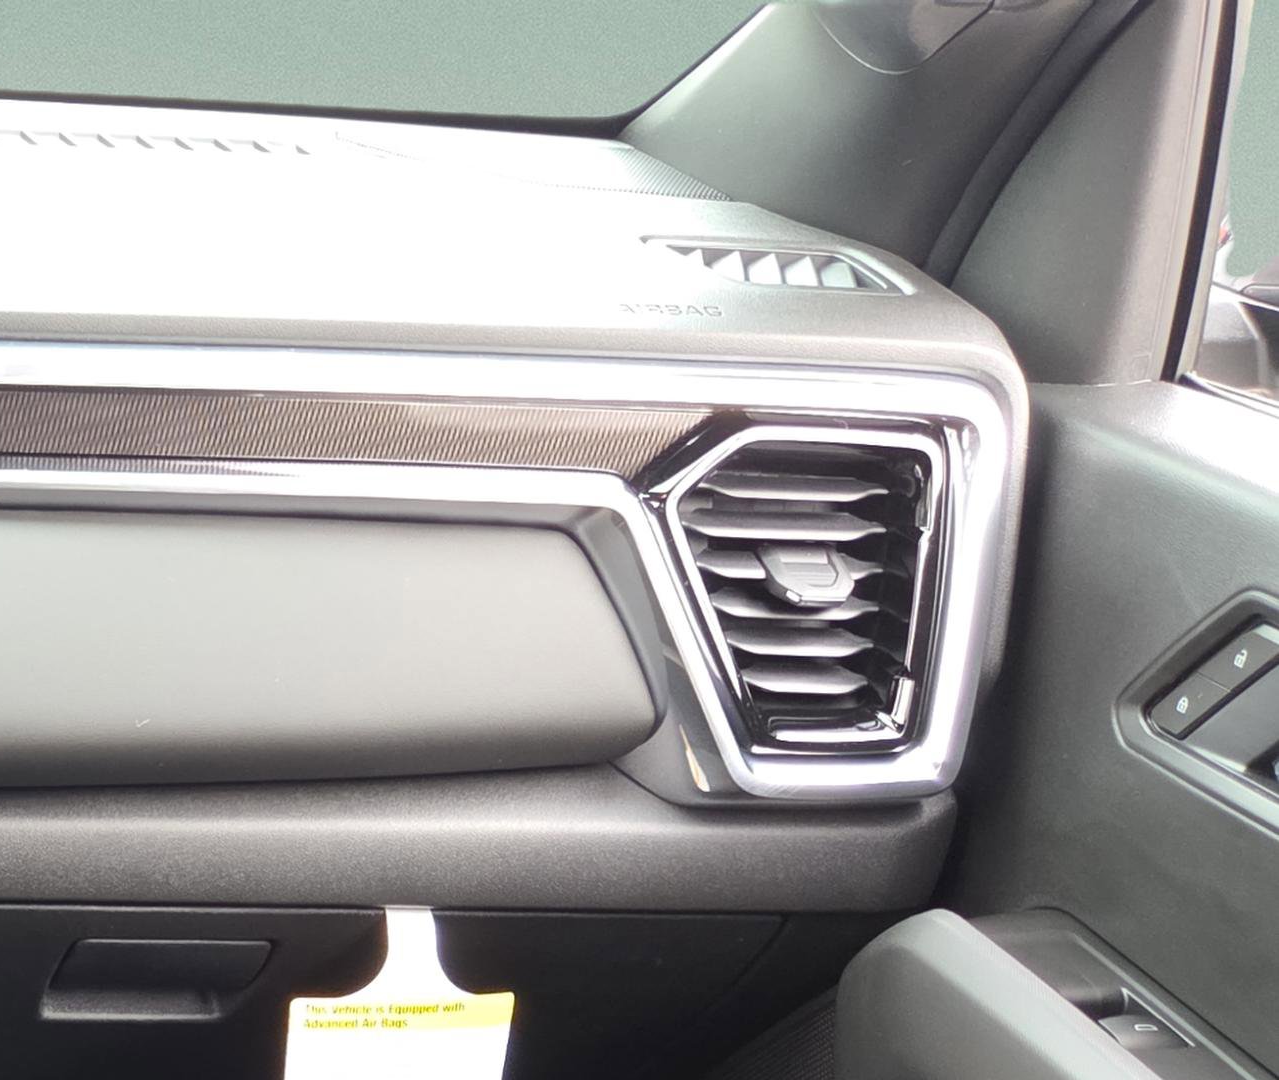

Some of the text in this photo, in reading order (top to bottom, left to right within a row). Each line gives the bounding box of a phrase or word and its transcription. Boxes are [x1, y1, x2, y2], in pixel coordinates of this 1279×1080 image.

[619, 303, 723, 318] ARBAG
[306, 1004, 326, 1014] This
[332, 1003, 371, 1014] Vehicle
[388, 1002, 439, 1016] Equipped
[442, 1001, 465, 1013] with
[303, 1018, 408, 1031] Advanced Air Bags
